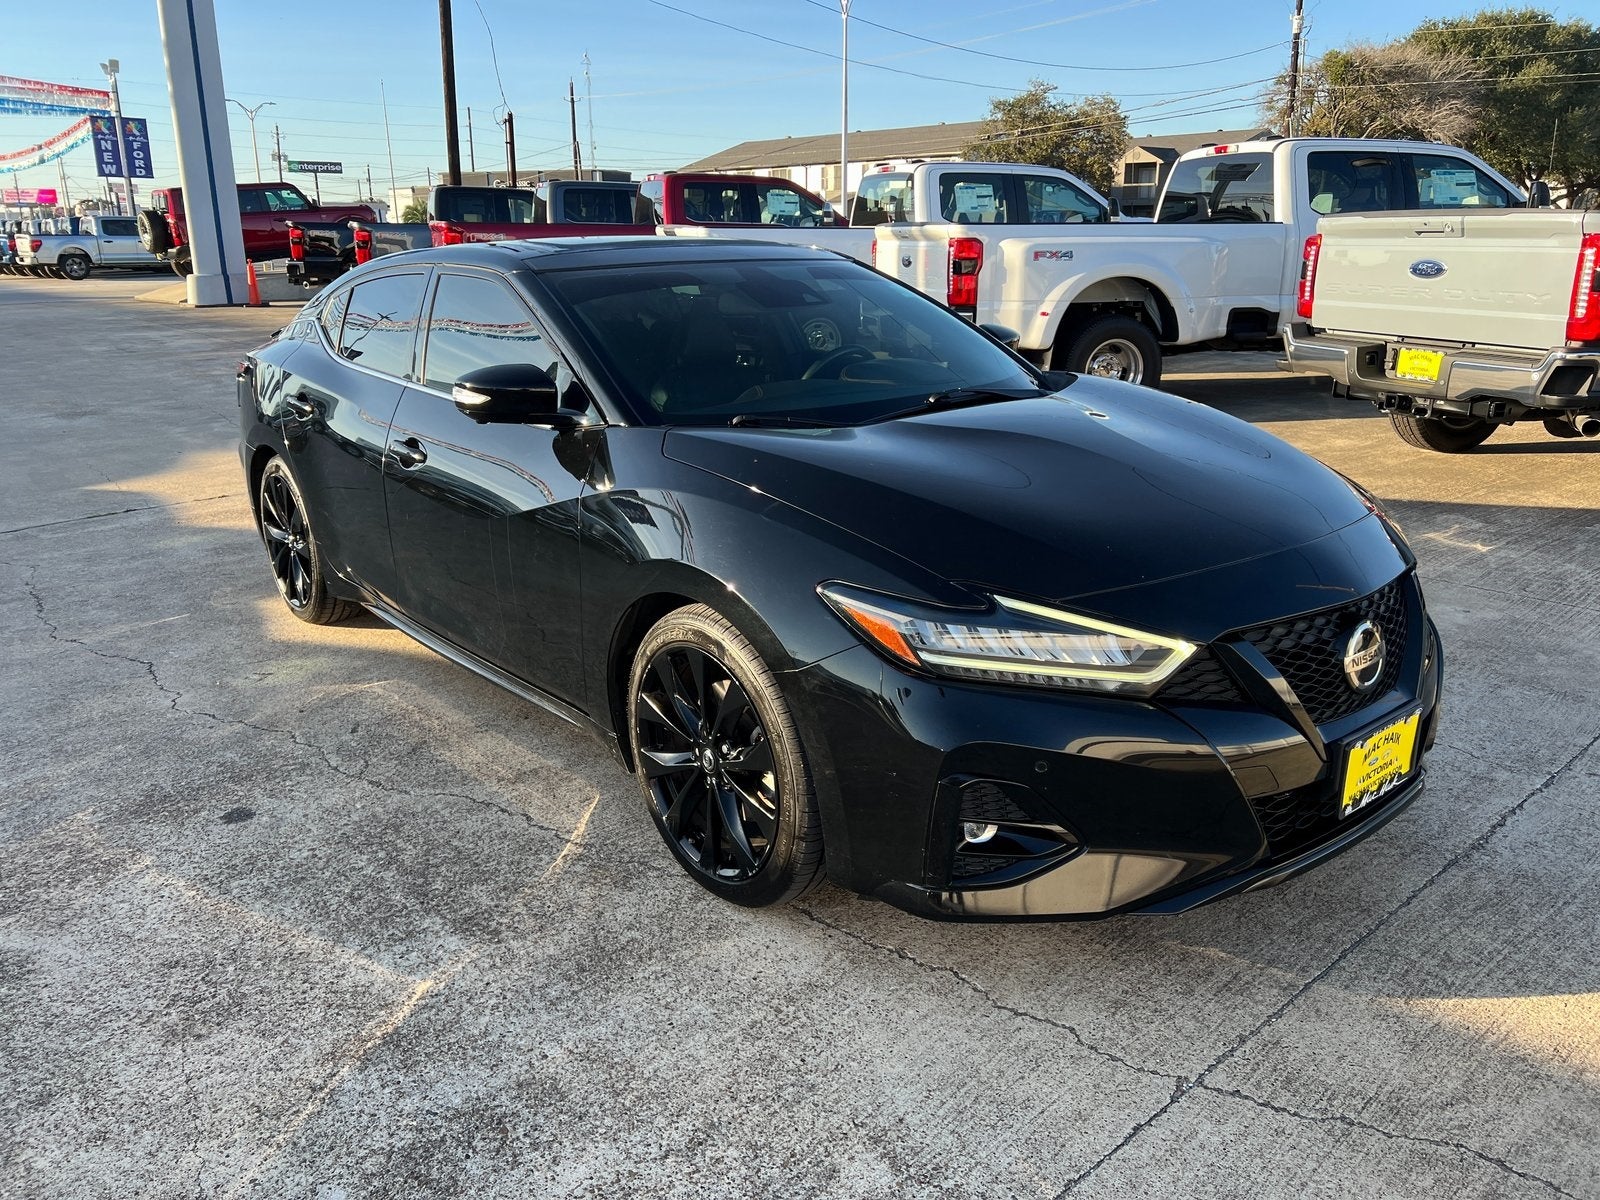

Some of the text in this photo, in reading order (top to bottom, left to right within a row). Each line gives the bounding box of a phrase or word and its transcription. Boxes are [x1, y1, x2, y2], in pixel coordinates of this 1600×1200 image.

[100, 140, 116, 174] NEW
[132, 141, 146, 176] FORD
[289, 163, 341, 172] enterprise
[1033, 250, 1073, 261] FX4
[1352, 648, 1379, 668] NISSA
[1362, 736, 1382, 766] MAC
